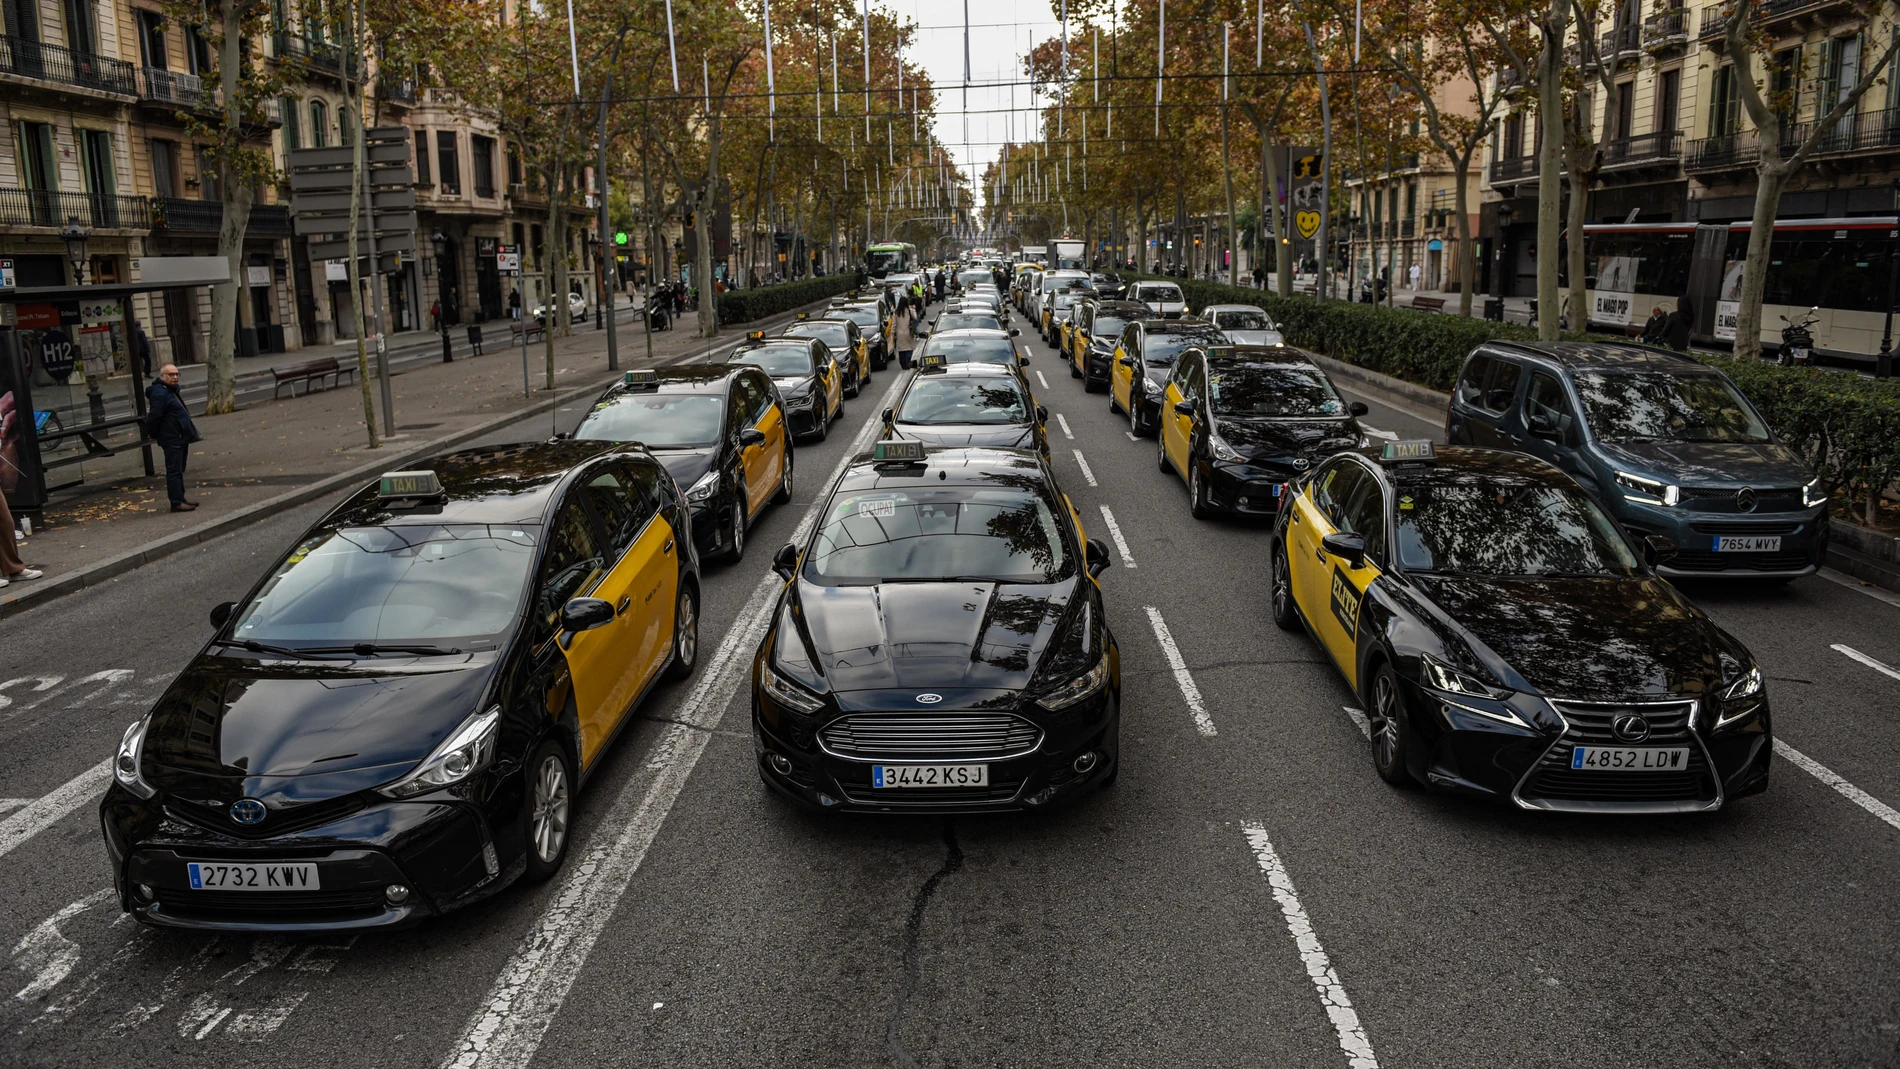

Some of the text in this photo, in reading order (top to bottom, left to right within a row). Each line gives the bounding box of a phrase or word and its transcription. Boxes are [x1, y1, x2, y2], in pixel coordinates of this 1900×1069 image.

[1597, 297, 1629, 315] EL MAGO POP
[1718, 314, 1737, 328] EL MAG
[43, 342, 73, 363] H12
[925, 357, 939, 365] TAXI
[633, 373, 646, 382] TAXI
[885, 444, 906, 457] TAXI
[1396, 443, 1419, 457] TAXI
[391, 477, 417, 493] TAXI
[860, 501, 893, 516] OCUPAT
[1721, 538, 1778, 550] 7654 MVY
[1332, 573, 1359, 622] ELITE
[1586, 750, 1637, 767] 4852
[1643, 750, 1682, 768] LDW
[886, 768, 938, 785] 3442
[943, 767, 982, 784] KSJ
[203, 866, 259, 886] 2732
[266, 867, 308, 887] KWV
